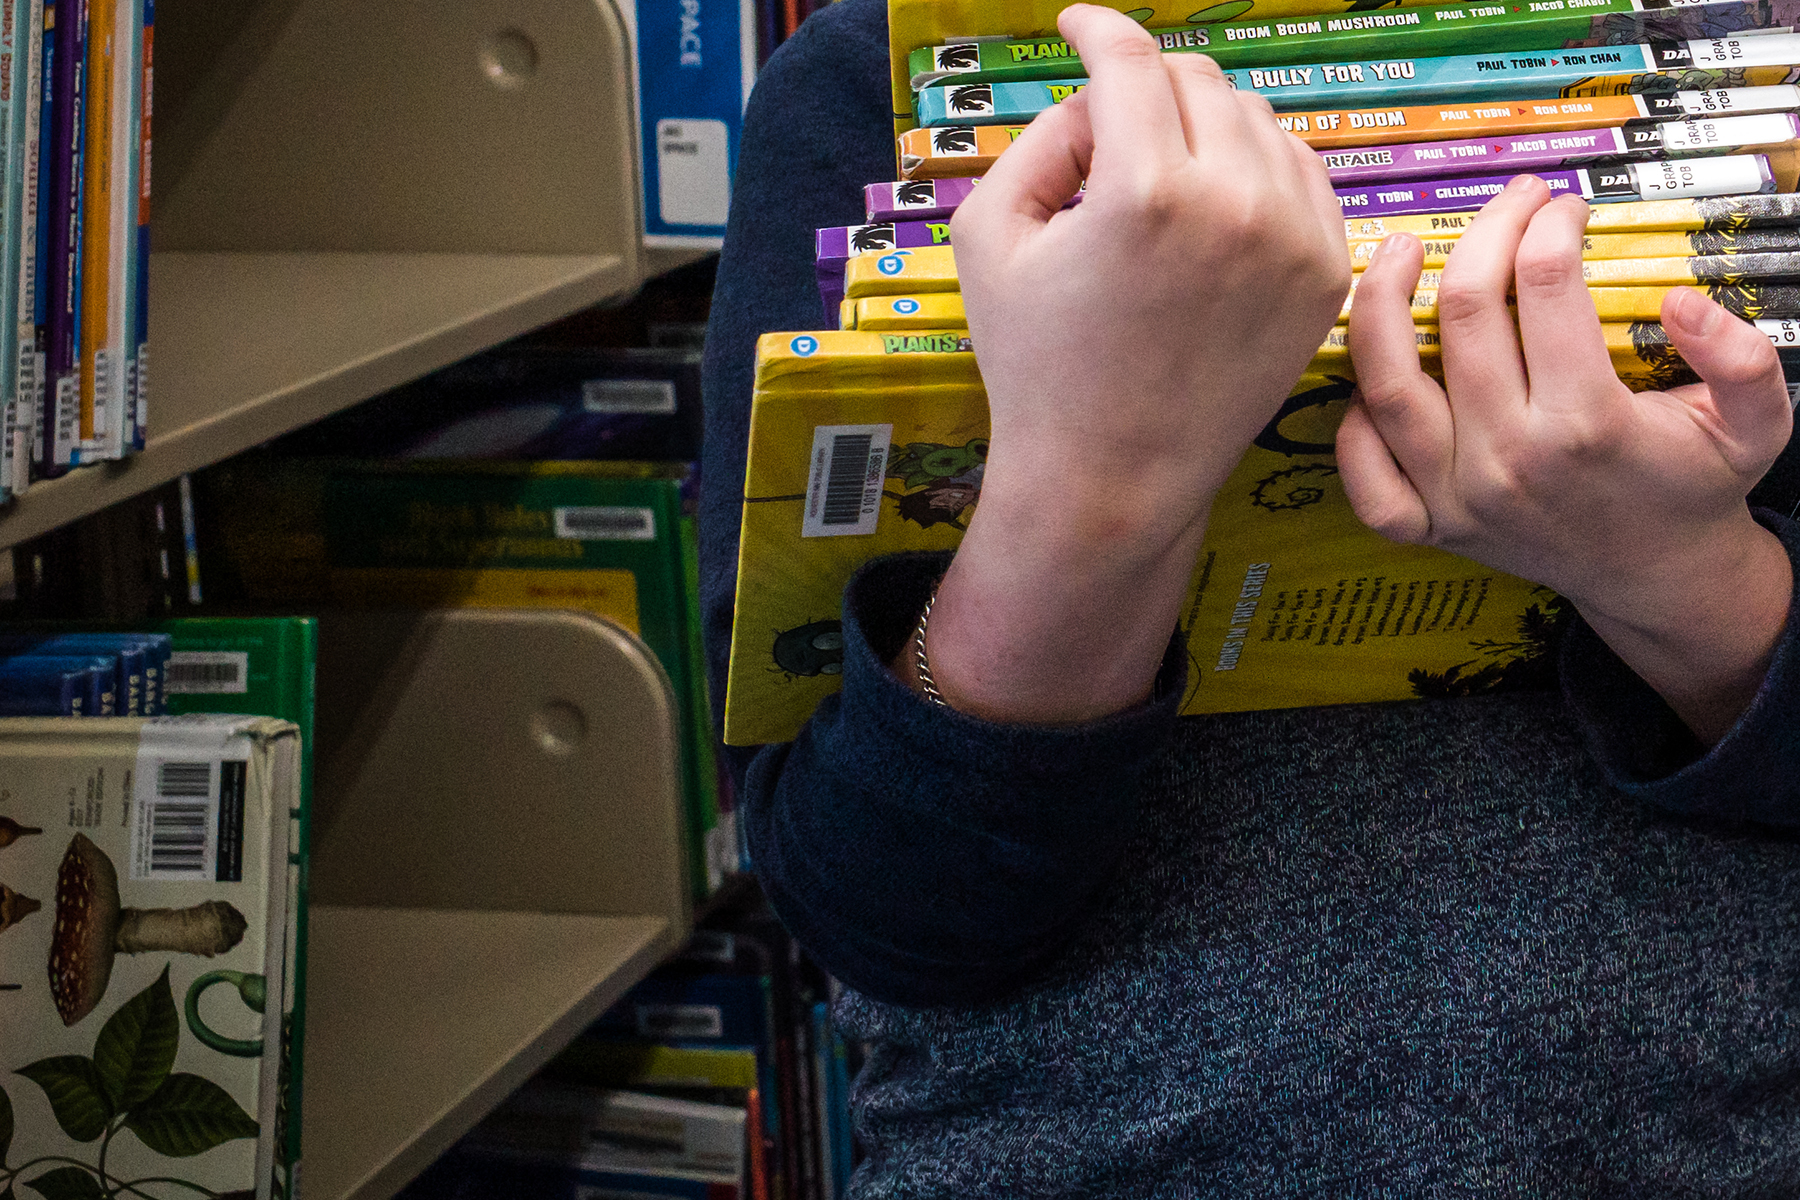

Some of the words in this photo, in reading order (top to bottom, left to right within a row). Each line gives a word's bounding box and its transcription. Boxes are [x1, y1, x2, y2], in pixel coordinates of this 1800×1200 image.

[1158, 28, 1211, 50] BIES
[1225, 24, 1271, 42] BOOM
[1276, 20, 1322, 38] BOOM
[1327, 12, 1421, 33] MUSHROOM
[1434, 9, 1466, 21] PAUL
[1468, 5, 1506, 19] TOBIN
[1528, 0, 1564, 13] JACOB
[1732, 40, 1744, 59] TOB
[1249, 67, 1312, 90] BULLY
[1324, 64, 1366, 84] FOR
[1369, 61, 1416, 81] YOU
[1476, 59, 1507, 71] PAUL
[1510, 56, 1547, 69] TOBIN
[1563, 54, 1588, 66] RON
[1591, 52, 1622, 64] CHAN
[1717, 90, 1734, 109] TOB
[1316, 114, 1340, 130] OF
[1347, 111, 1407, 129] DOOM
[1439, 109, 1471, 121] PAUL
[1473, 107, 1511, 119] TOBIN
[1533, 104, 1558, 116] RON
[1560, 103, 1593, 115] CHAN
[1706, 121, 1719, 144] TOB
[1414, 148, 1446, 161] PAUL
[1451, 144, 1487, 157] TOBIN
[1510, 140, 1547, 153] JACOB
[1550, 135, 1597, 150] CHABOT
[1682, 165, 1695, 188] TOB
[1376, 189, 1415, 204] TOBIN
[1360, 219, 1386, 235] #3
[1431, 216, 1466, 229] PAUL
[880, 333, 959, 354] PLANTS
[1240, 562, 1271, 598] SERIES
[1230, 601, 1258, 624] THIS
[1226, 627, 1248, 638] IN
[1214, 640, 1244, 672] BOOKS
